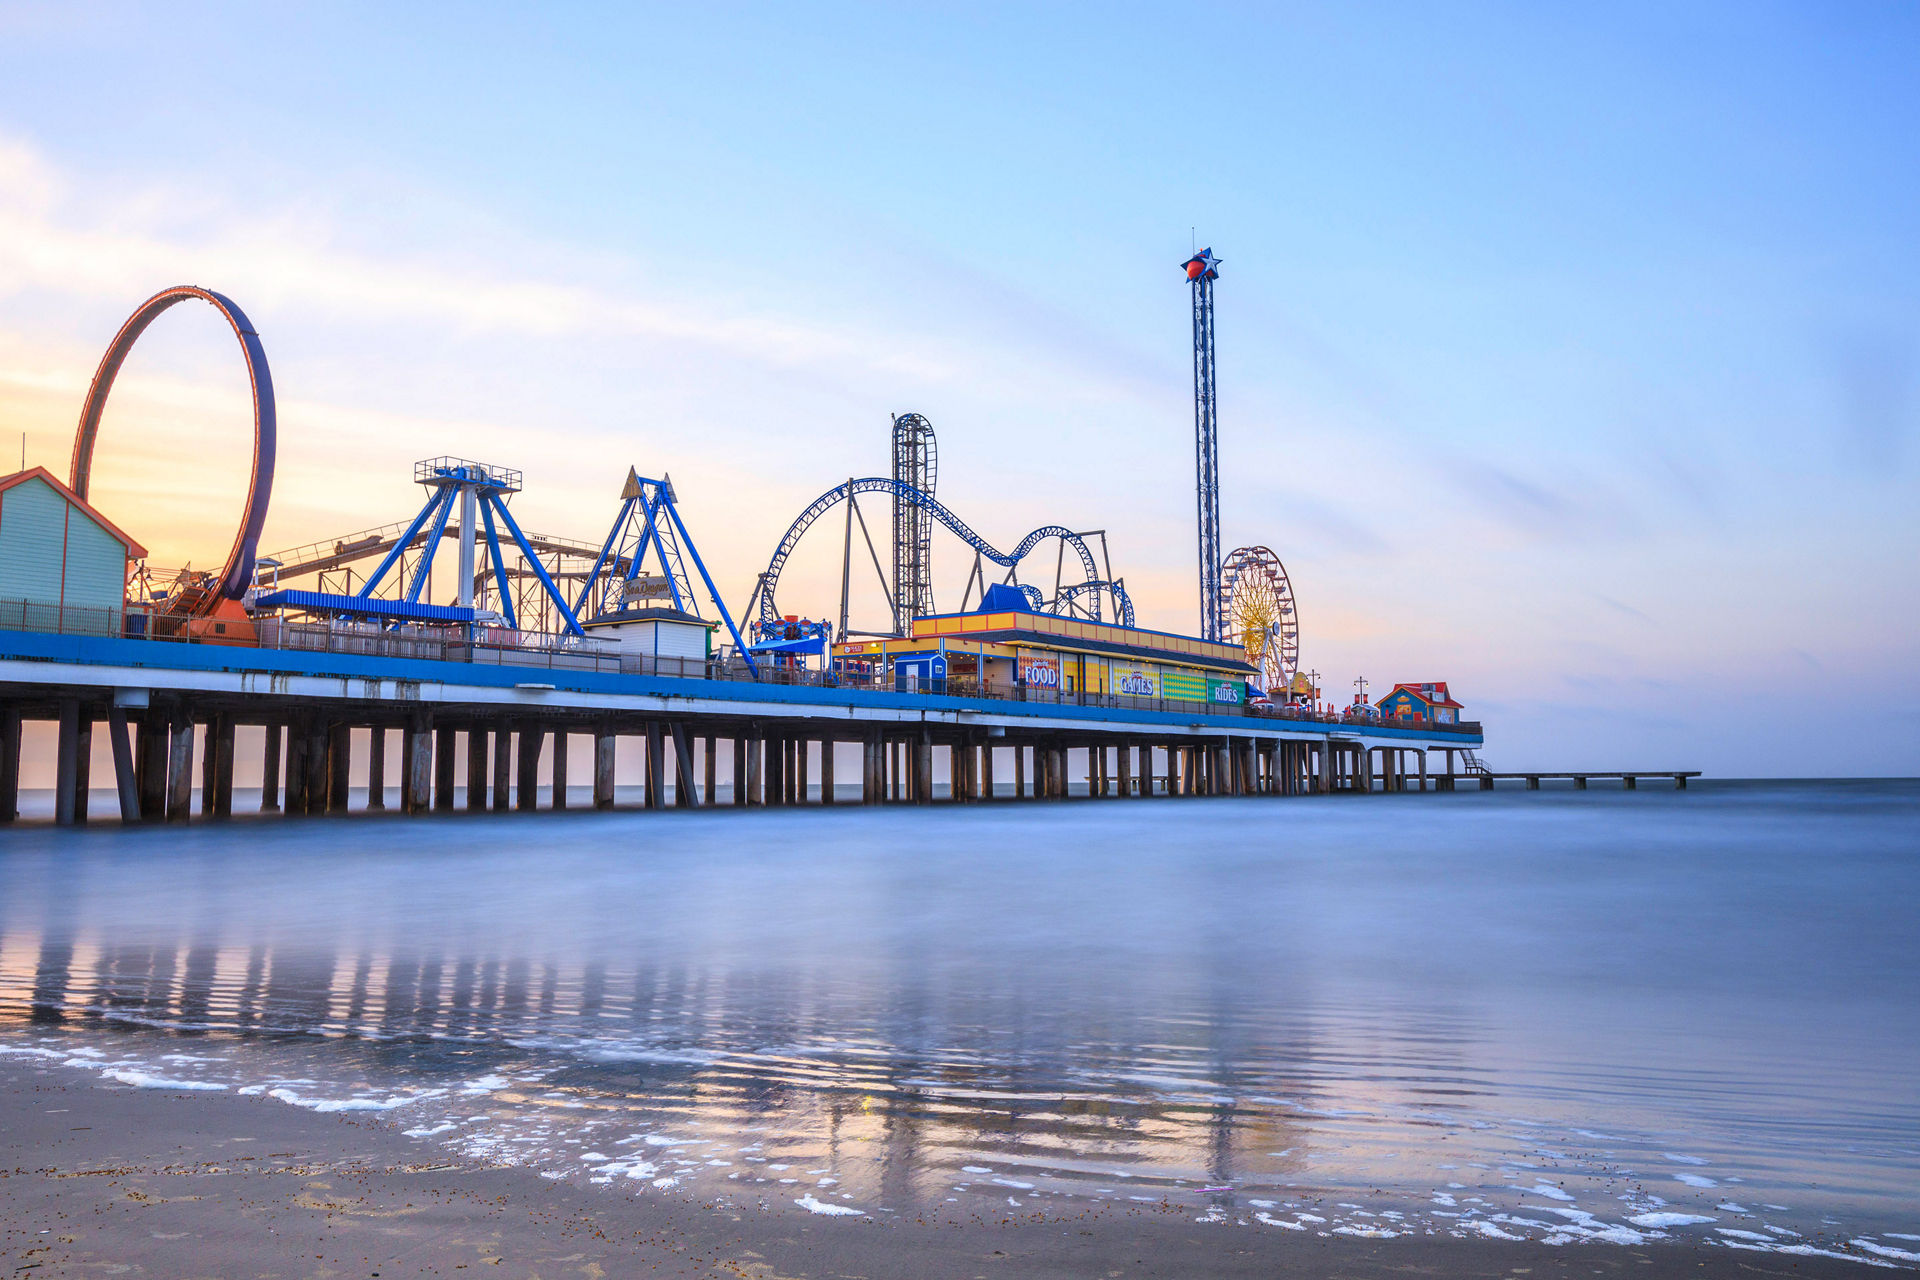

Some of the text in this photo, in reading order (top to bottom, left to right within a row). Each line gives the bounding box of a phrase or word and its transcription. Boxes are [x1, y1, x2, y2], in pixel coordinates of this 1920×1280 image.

[625, 581, 639, 595] Sea
[1025, 666, 1057, 686] FOOD
[1120, 676, 1153, 695] GAMES
[1215, 687, 1238, 703] RIDES
